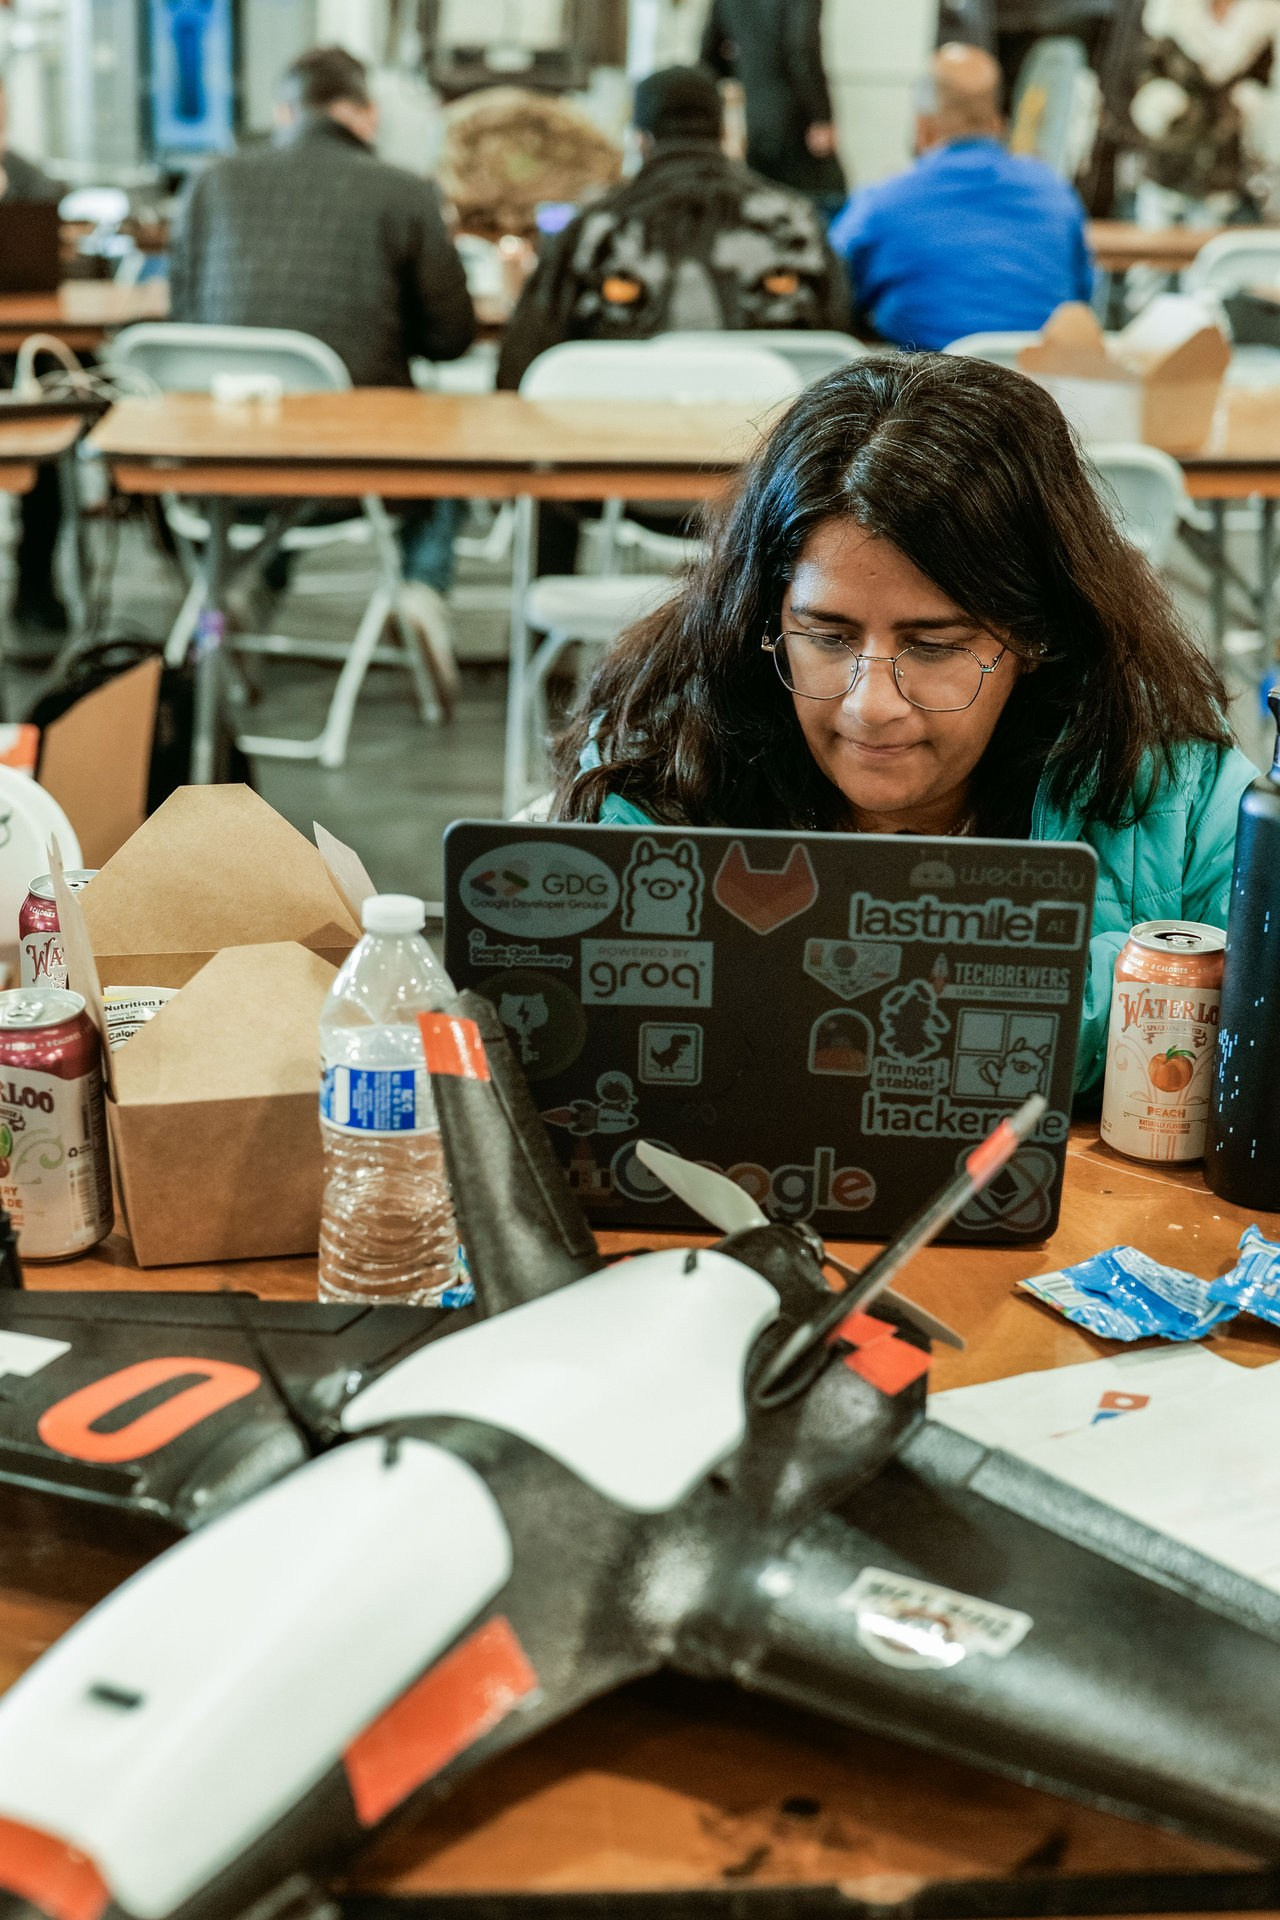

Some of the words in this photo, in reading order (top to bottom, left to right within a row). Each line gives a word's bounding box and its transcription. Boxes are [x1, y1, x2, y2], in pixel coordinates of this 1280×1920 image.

[960, 859, 1086, 892] wechaty
[542, 873, 608, 895] GDG
[512, 898, 565, 910] Developer
[568, 899, 608, 911] Groups
[598, 946, 668, 957] POWERED
[672, 948, 689, 958] BY
[954, 963, 1071, 989] TECHBREWERS
[1156, 965, 1189, 974] CALORIES
[589, 961, 700, 1000] groq
[104, 1000, 156, 1012] Nutrition
[878, 1060, 902, 1075] I'm
[906, 1065, 934, 1077] not
[1146, 1105, 1186, 1118] PEACH
